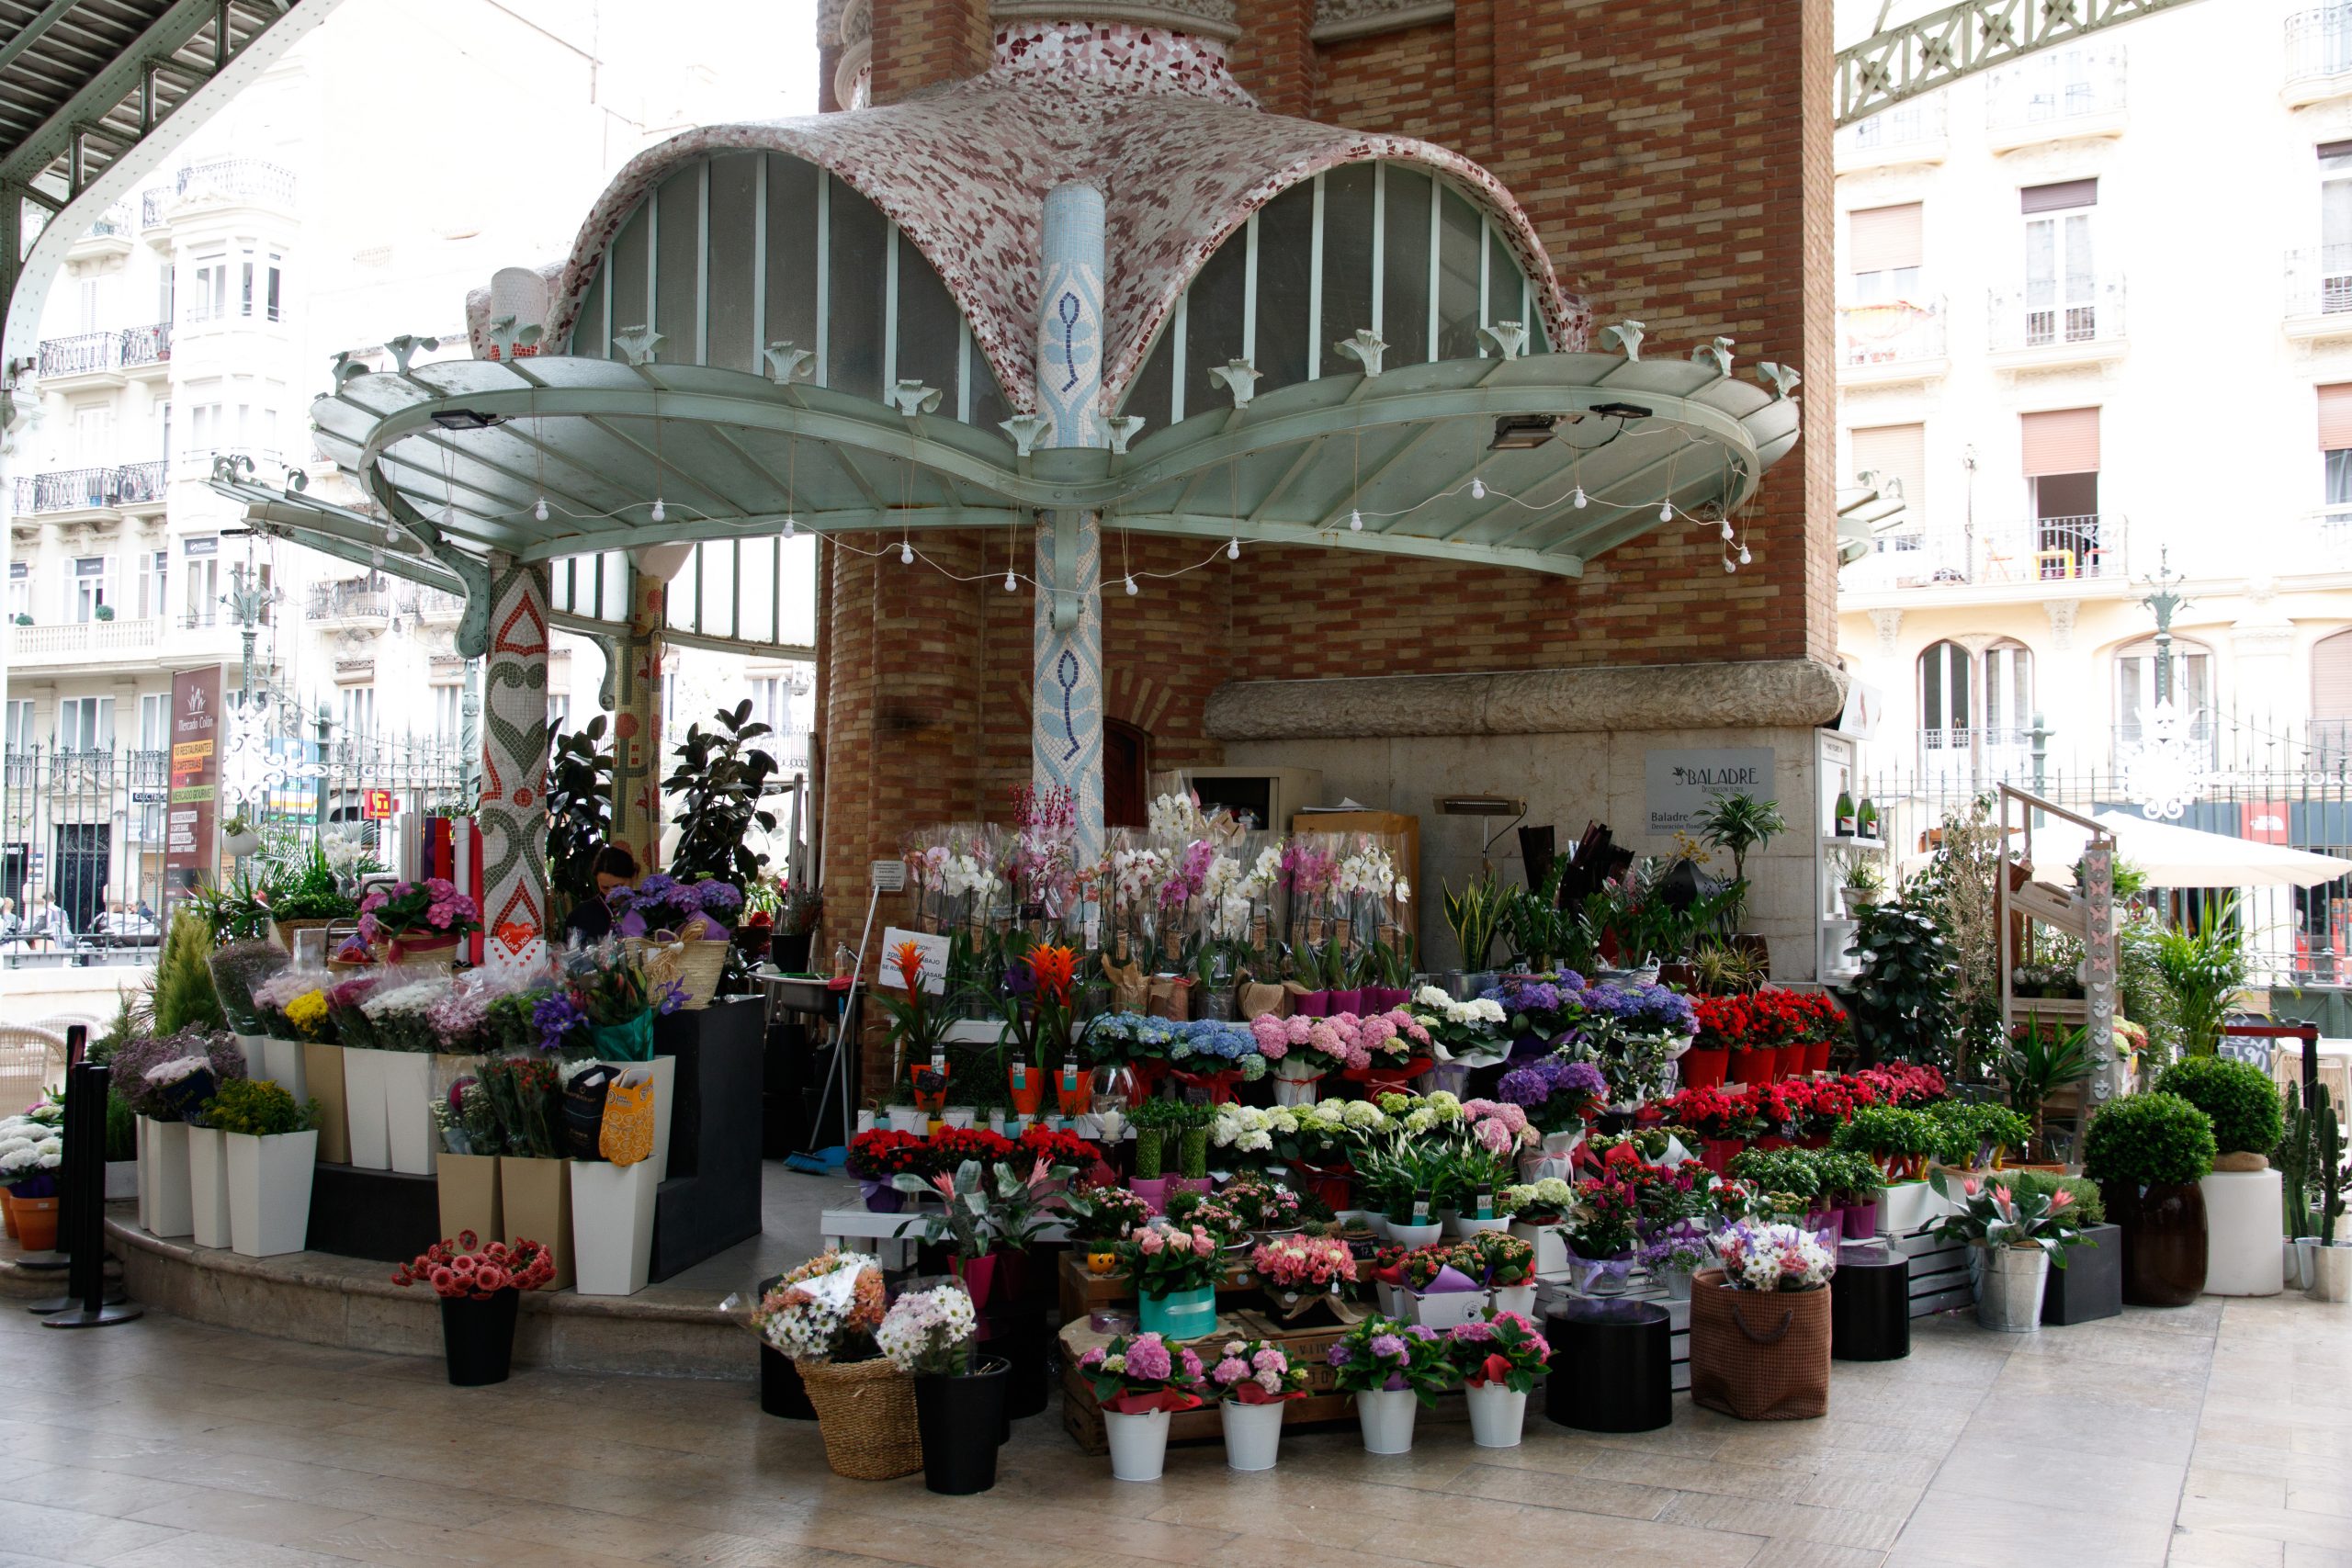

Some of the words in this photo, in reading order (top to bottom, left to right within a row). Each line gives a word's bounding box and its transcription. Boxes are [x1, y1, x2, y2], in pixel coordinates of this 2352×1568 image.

[178, 717, 198, 731] Mercado
[180, 742, 212, 755] RESTAURANTES
[1688, 767, 1759, 785] BALADRE
[172, 789, 192, 802] MERCADO
[193, 787, 213, 800] GOURMET
[1651, 812, 1689, 822] Baladre
[504, 936, 519, 951] Love
[922, 970, 943, 978] PASAR
